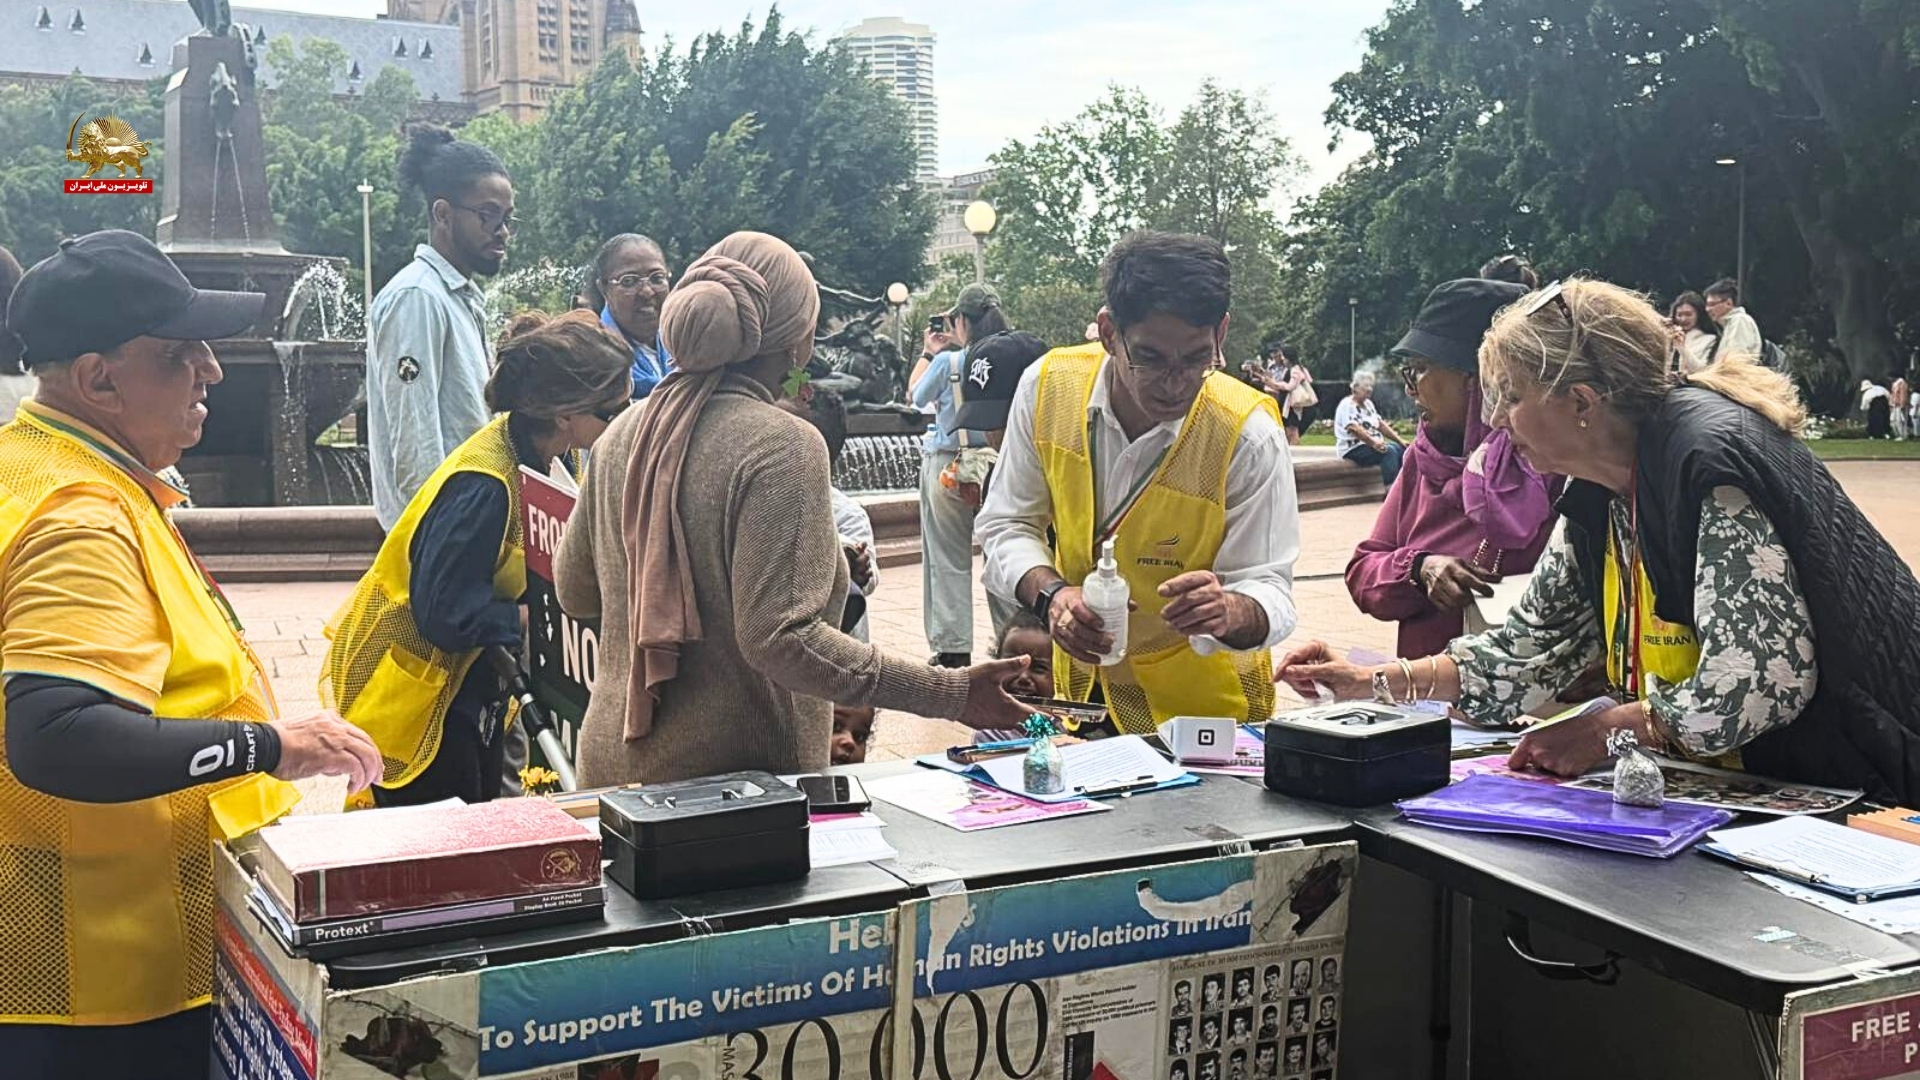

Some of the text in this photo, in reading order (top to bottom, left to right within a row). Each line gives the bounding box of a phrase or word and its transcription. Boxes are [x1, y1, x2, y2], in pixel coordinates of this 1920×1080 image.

[528, 503, 566, 554] FRO
[1663, 635, 1691, 646] IRAN
[829, 913, 895, 954] Hel
[479, 1025, 514, 1051] To
[523, 1004, 642, 1045] Support
[651, 996, 703, 1024] The
[712, 981, 811, 1013] Victims
[821, 968, 856, 996] Of
[969, 937, 1045, 967] Rights
[1053, 918, 1170, 953] Violations
[1852, 1011, 1910, 1043] FREE
